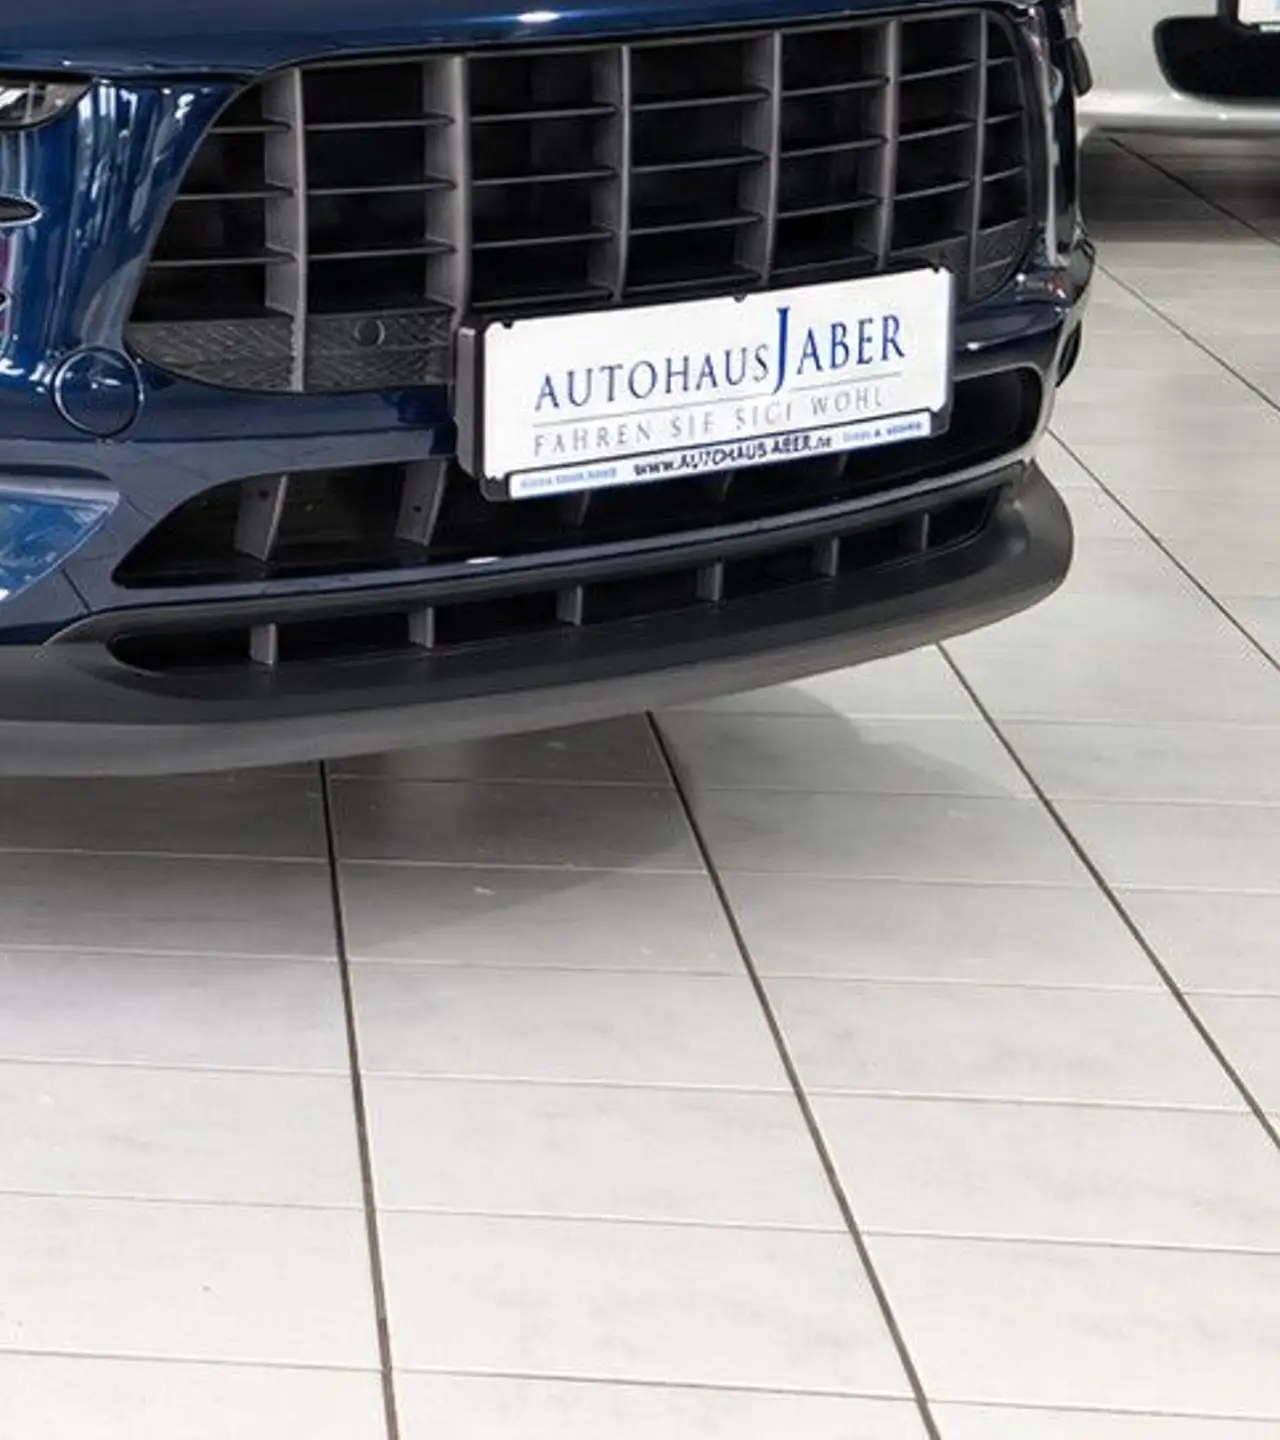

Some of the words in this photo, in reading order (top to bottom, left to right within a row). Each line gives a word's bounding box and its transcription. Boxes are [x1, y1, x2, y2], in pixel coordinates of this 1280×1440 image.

[535, 343, 770, 412] AUTOHAUS
[771, 306, 906, 396] JABER
[534, 420, 651, 458] FAHREN
[810, 386, 883, 416] WOHL
